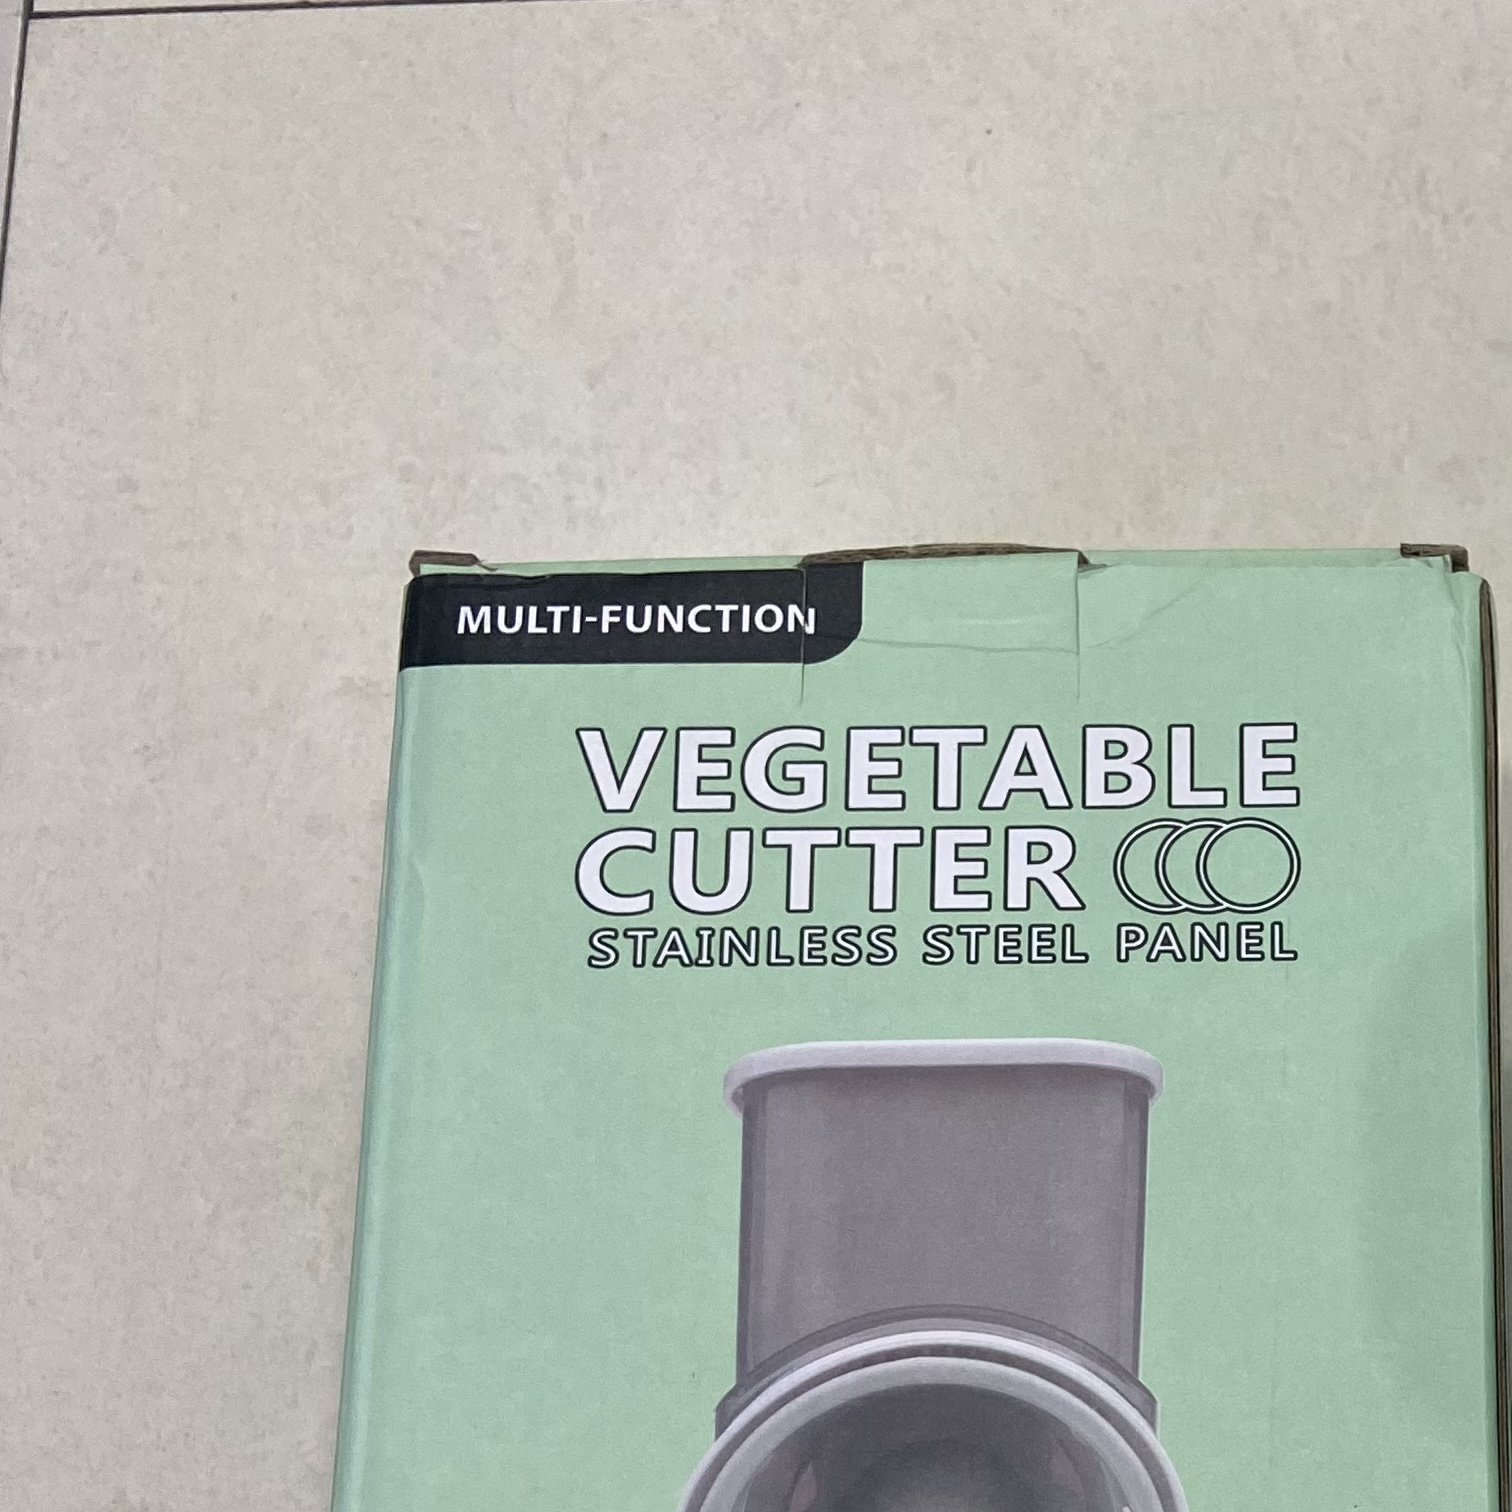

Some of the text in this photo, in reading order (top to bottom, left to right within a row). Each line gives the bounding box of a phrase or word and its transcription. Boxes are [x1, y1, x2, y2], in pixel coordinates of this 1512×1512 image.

[456, 603, 816, 635] MULTI-FUNCTION
[575, 722, 1300, 813] VEGETABLE
[574, 826, 1086, 915] CUTTER
[588, 921, 1298, 968] STAINLESS STEEL PANEL
